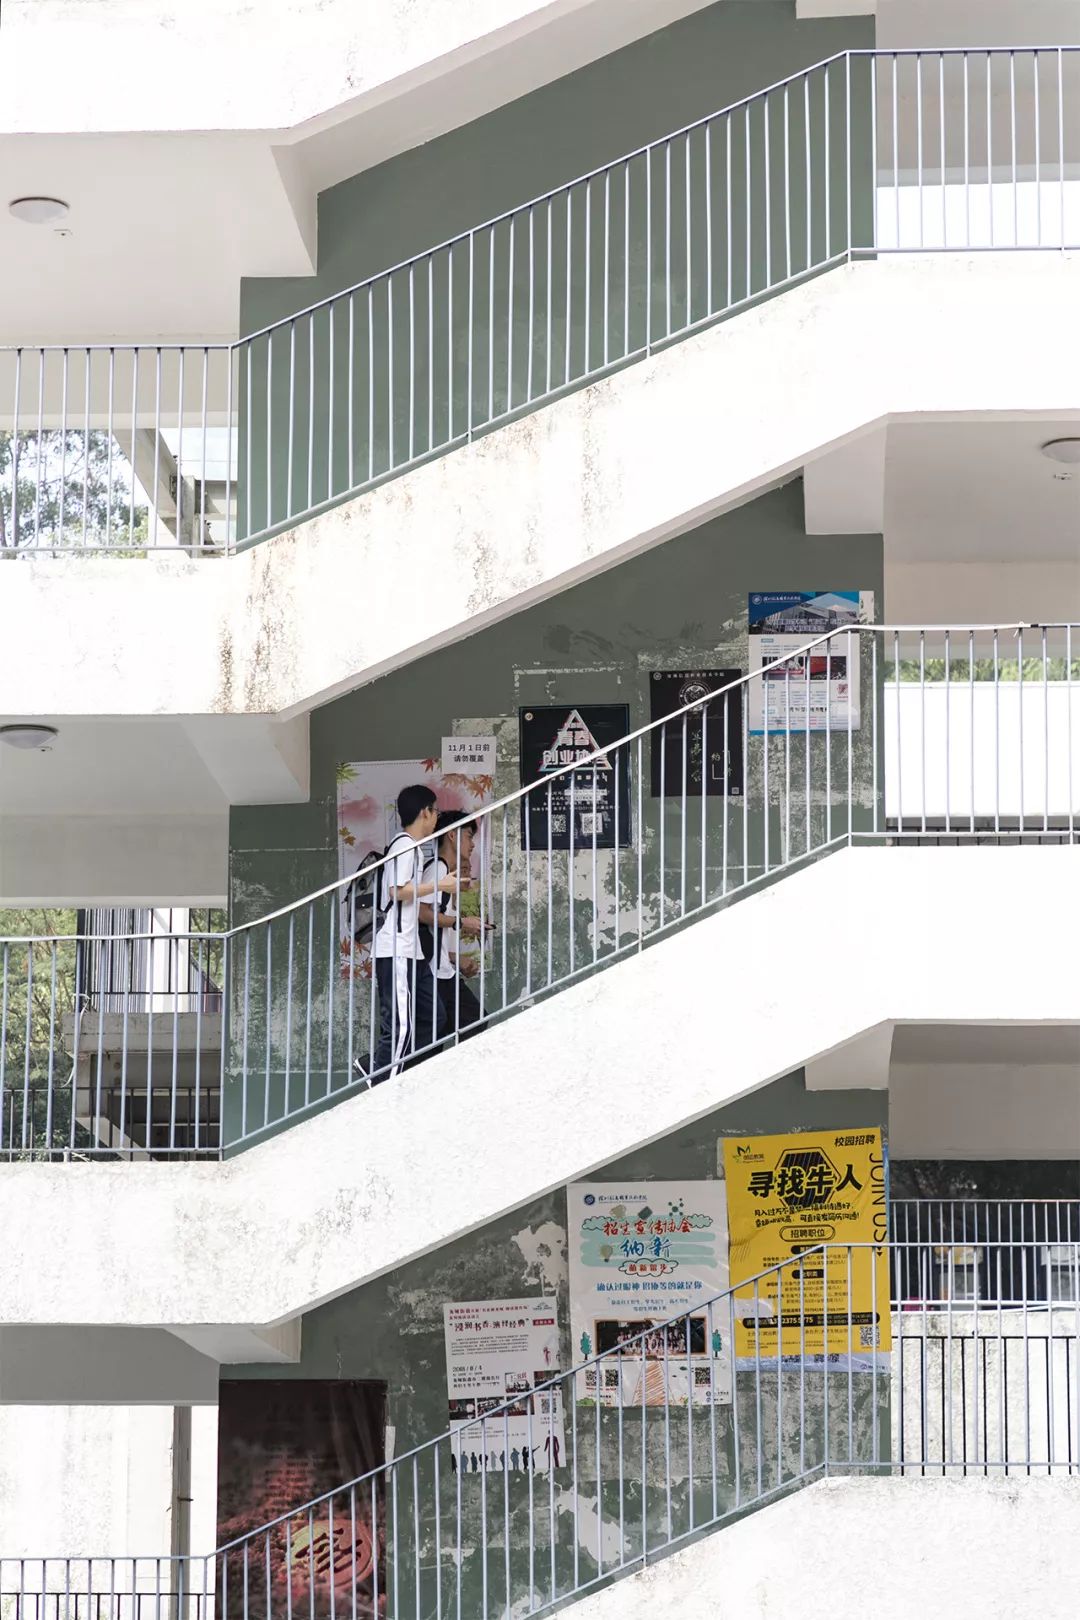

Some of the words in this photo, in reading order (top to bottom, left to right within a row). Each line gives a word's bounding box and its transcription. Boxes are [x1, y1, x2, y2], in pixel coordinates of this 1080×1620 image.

[454, 754, 484, 763] 请勿覆盖
[834, 1134, 876, 1148] 校园招聘
[748, 1163, 864, 1199] 寻找牛人
[790, 1228, 826, 1239] 招聘职位
[620, 1236, 673, 1259] 纳新
[597, 1281, 641, 1292] 确认过眼神
